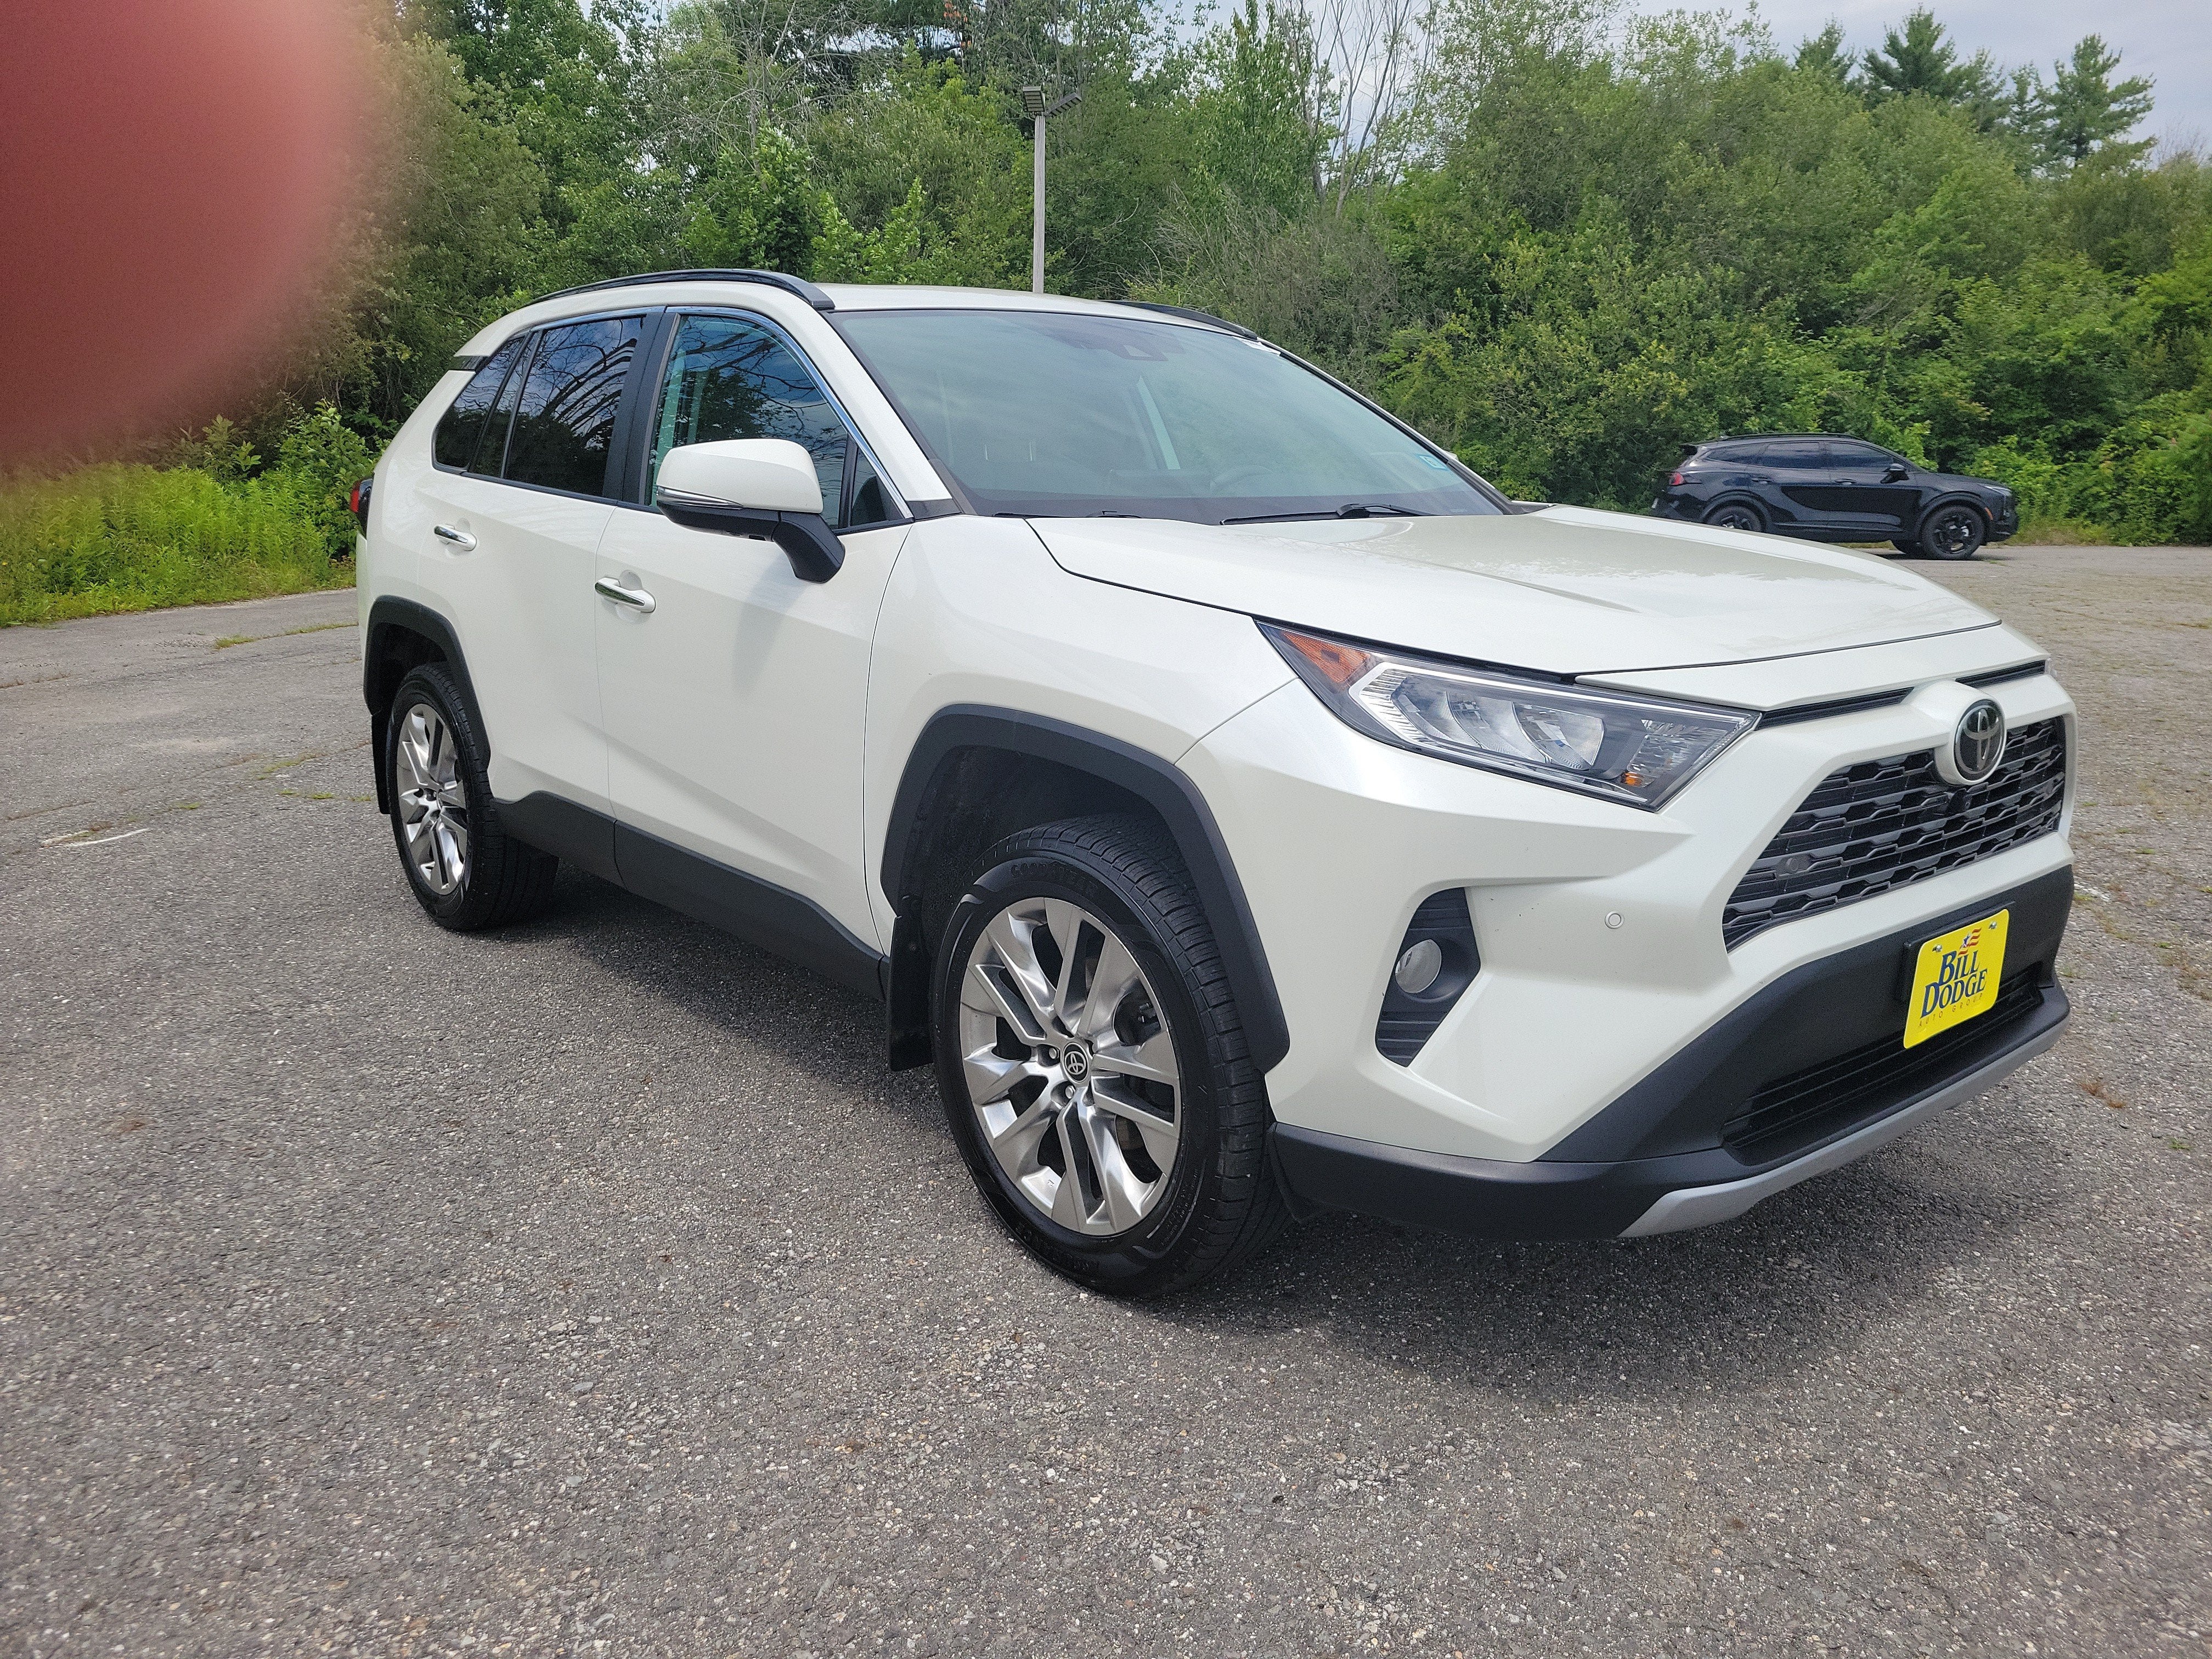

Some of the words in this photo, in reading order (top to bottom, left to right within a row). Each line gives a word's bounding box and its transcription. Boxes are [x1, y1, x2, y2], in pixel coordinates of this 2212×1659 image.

[1938, 950, 1980, 986] BILL
[1918, 1010, 1943, 1028] AUTO
[1952, 992, 1983, 1012] GROUP
[1920, 968, 1988, 1018] DODGE
